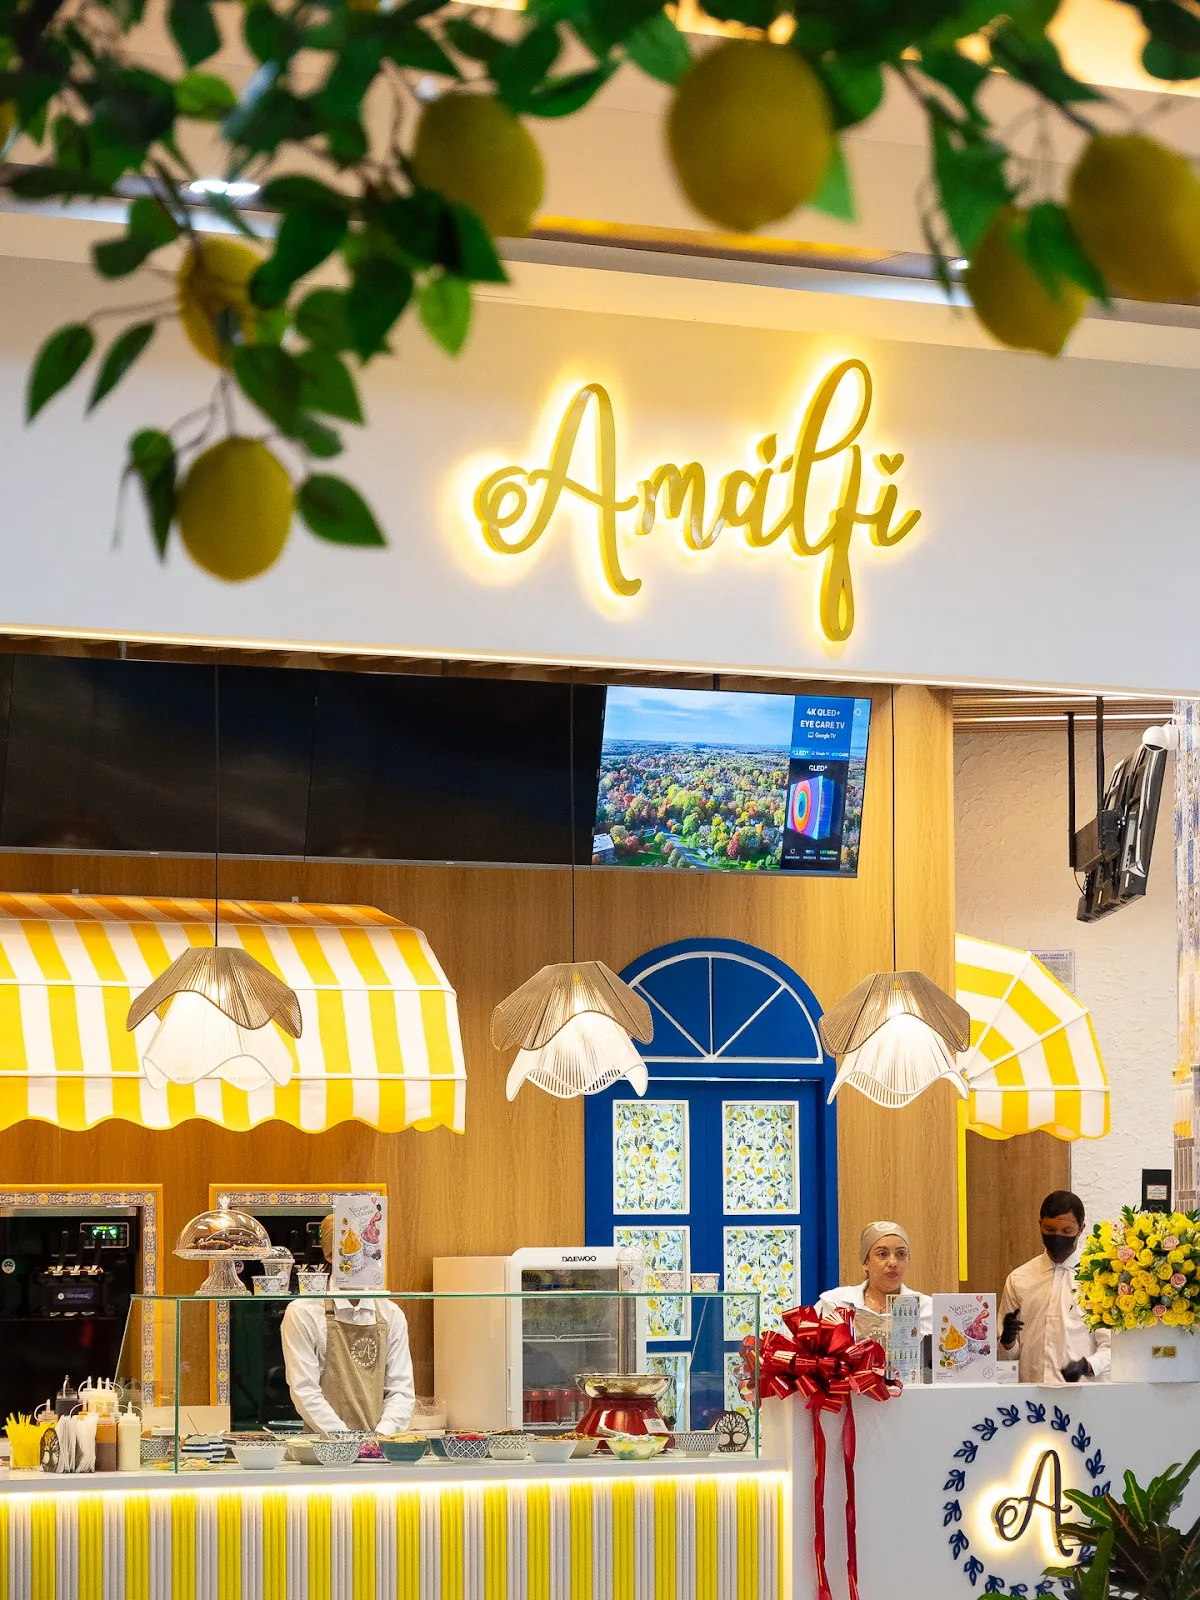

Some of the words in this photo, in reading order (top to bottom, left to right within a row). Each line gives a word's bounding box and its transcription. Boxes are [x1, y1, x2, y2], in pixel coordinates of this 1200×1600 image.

[474, 358, 922, 642] Amalfi
[806, 707, 816, 716] 4K
[800, 719, 815, 728] EYE
[815, 720, 835, 729] CARE
[836, 721, 845, 729] TV
[815, 732, 830, 740] Google
[562, 1255, 597, 1263] DAEWOO
[991, 1450, 1073, 1557] A
